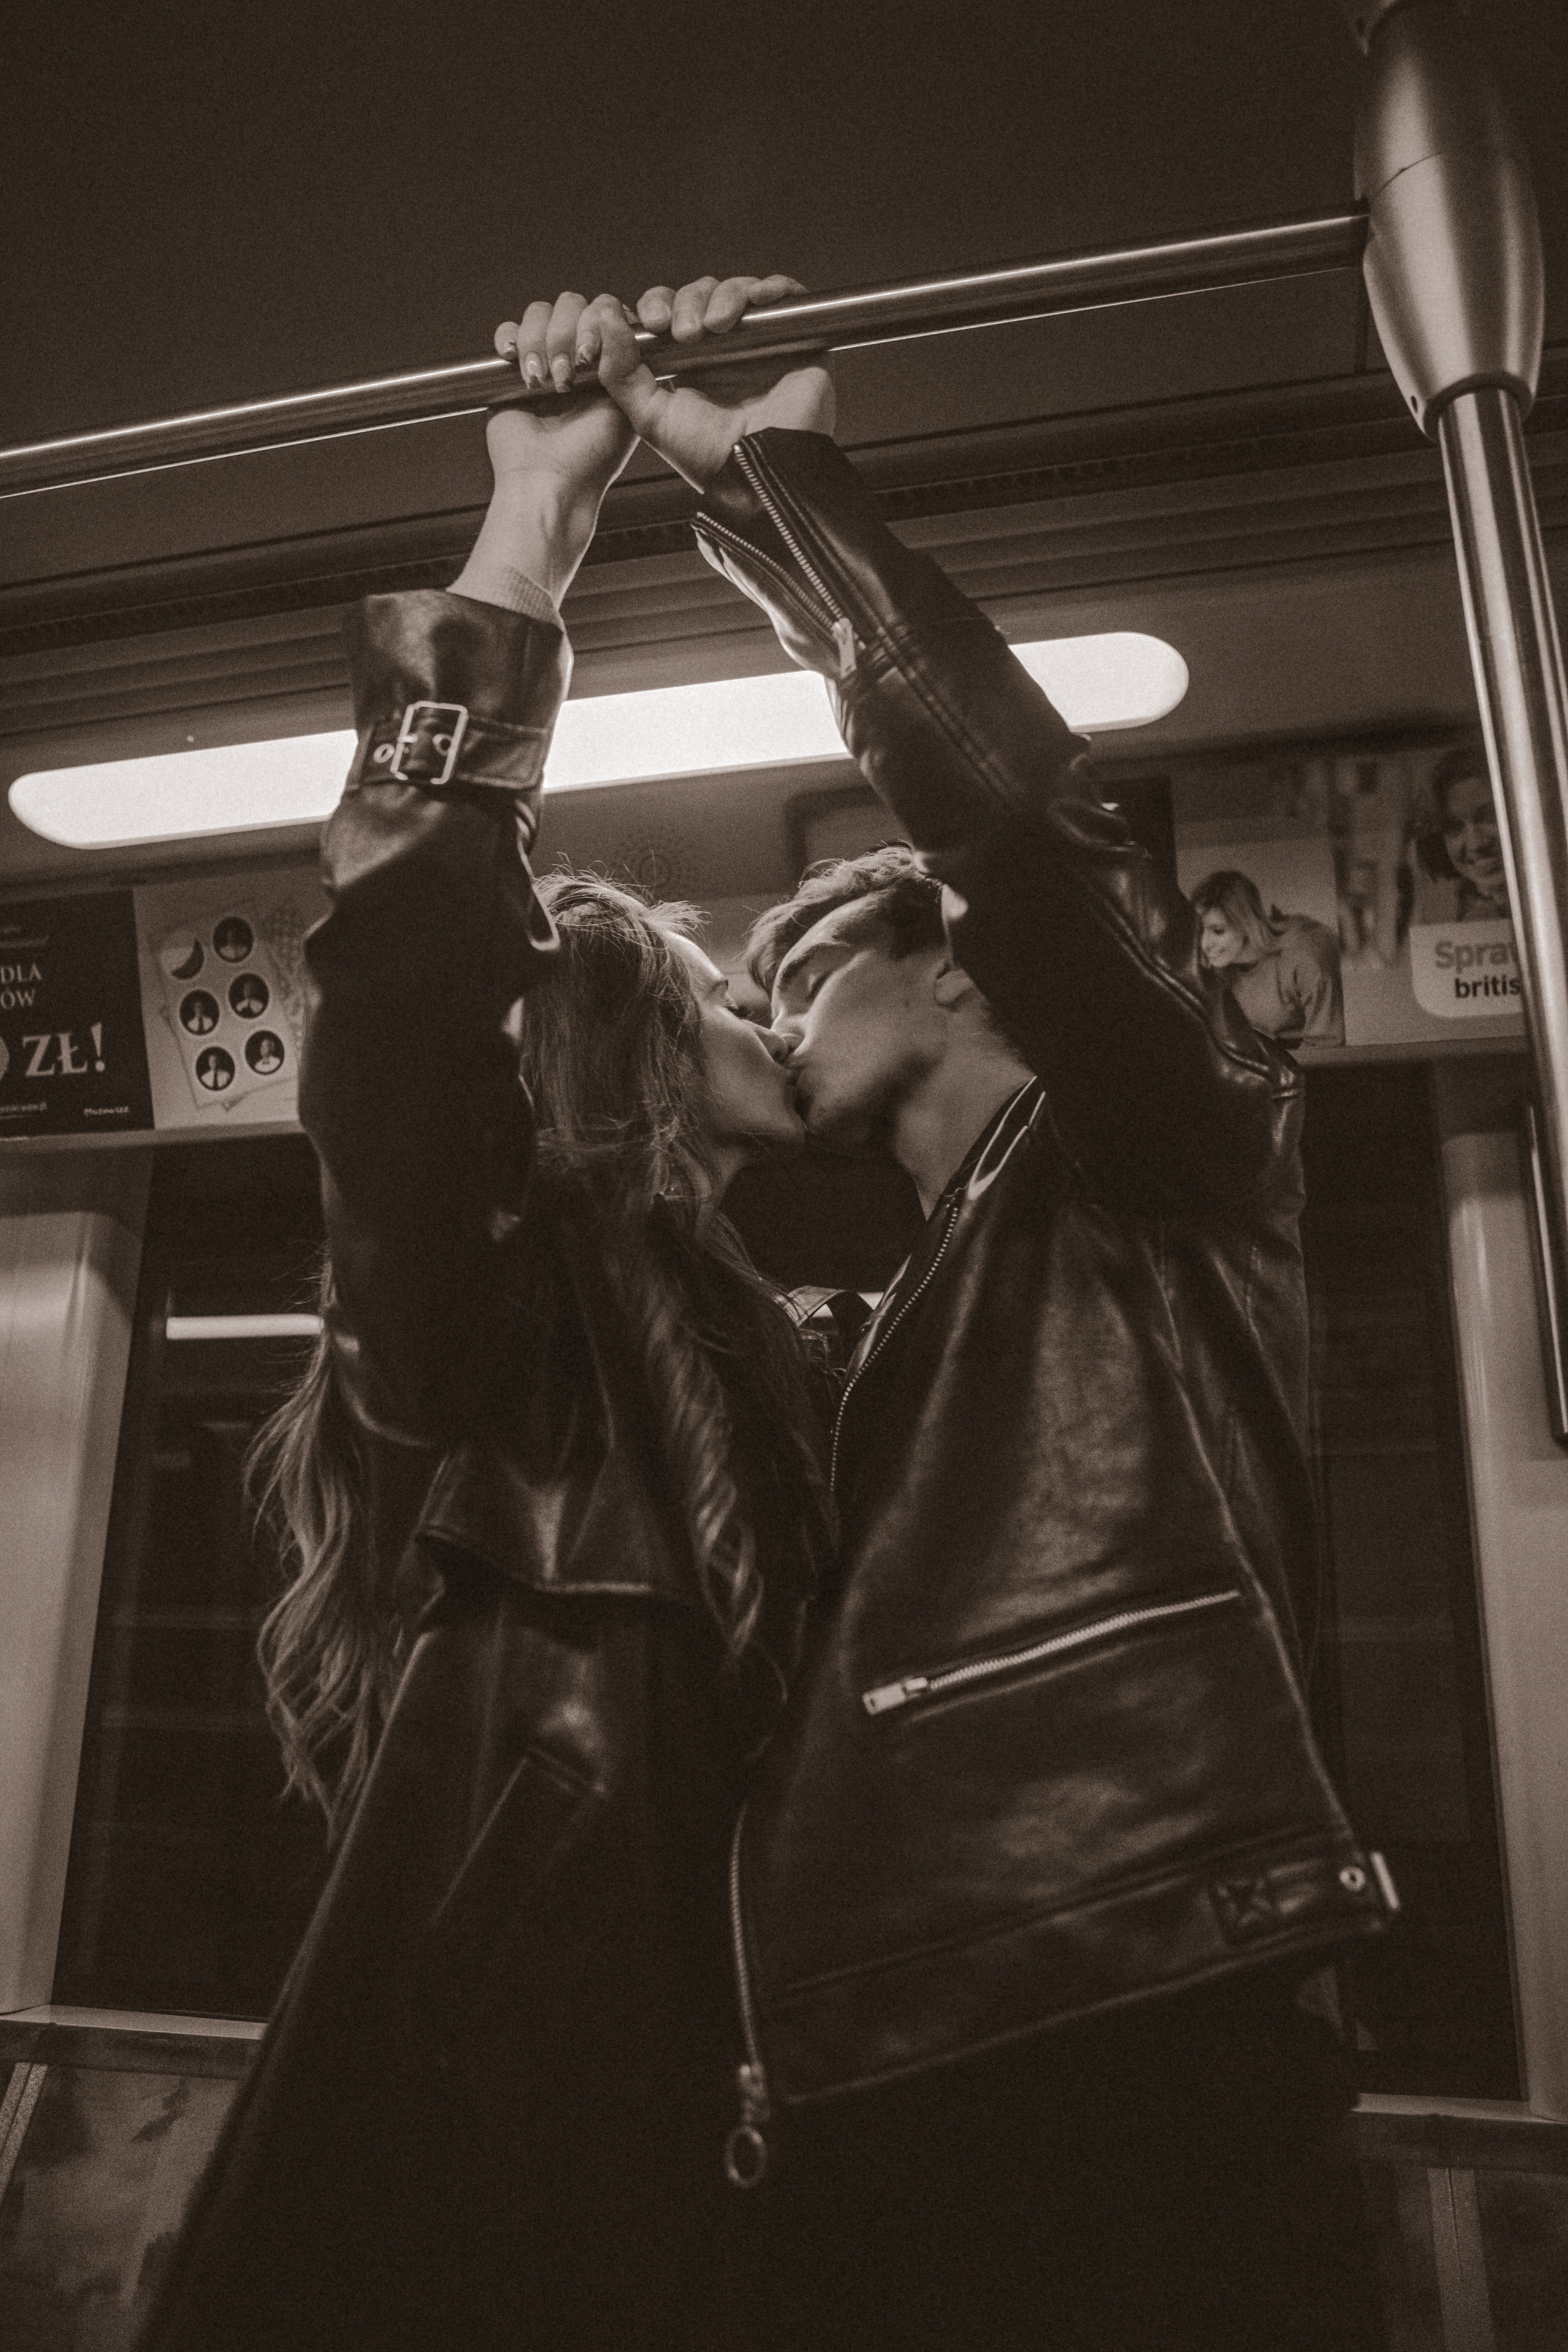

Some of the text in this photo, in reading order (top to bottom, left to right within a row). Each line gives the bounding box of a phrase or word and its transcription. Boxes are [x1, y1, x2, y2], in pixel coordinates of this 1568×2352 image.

[1, 963, 42, 984] DLA
[1455, 974, 1521, 998] britis
[0, 987, 36, 1010] ÓW
[22, 1022, 105, 1077] ZŁ!
